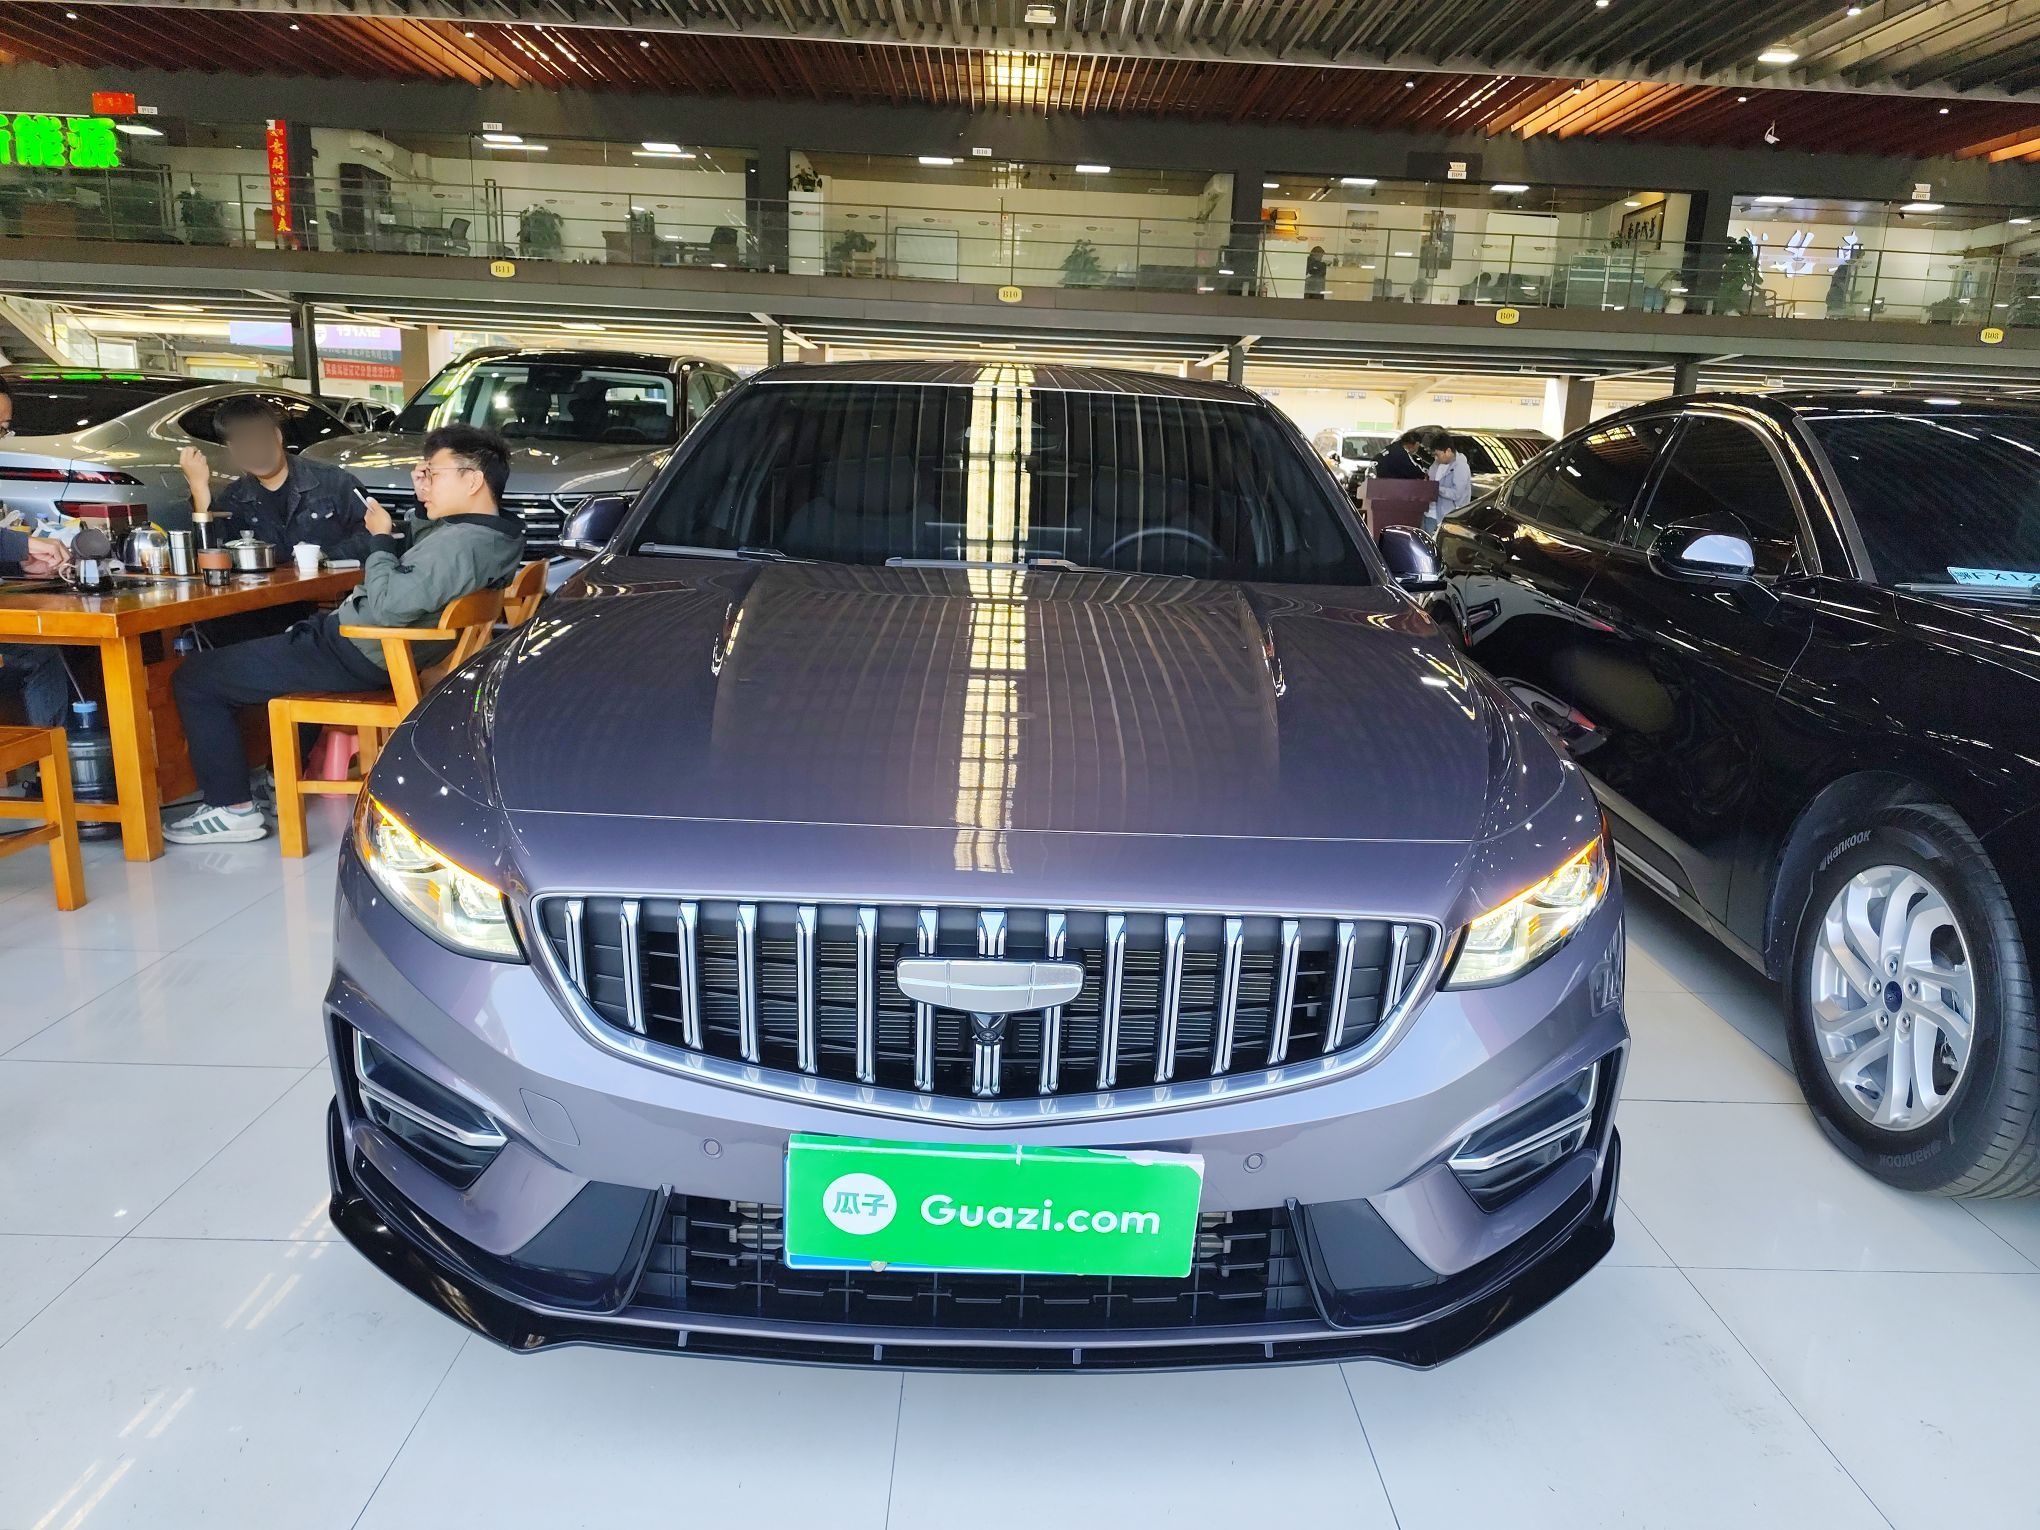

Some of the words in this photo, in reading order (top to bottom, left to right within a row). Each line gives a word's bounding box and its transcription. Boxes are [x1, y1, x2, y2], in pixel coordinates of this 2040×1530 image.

[0, 113, 119, 168] 能源
[495, 265, 511, 274] B11
[1002, 290, 1018, 299] B10
[1500, 312, 1515, 320] B09
[1984, 331, 2000, 340] B08
[832, 1190, 889, 1218] 瓜子
[920, 1194, 1160, 1235] Guazi.com
